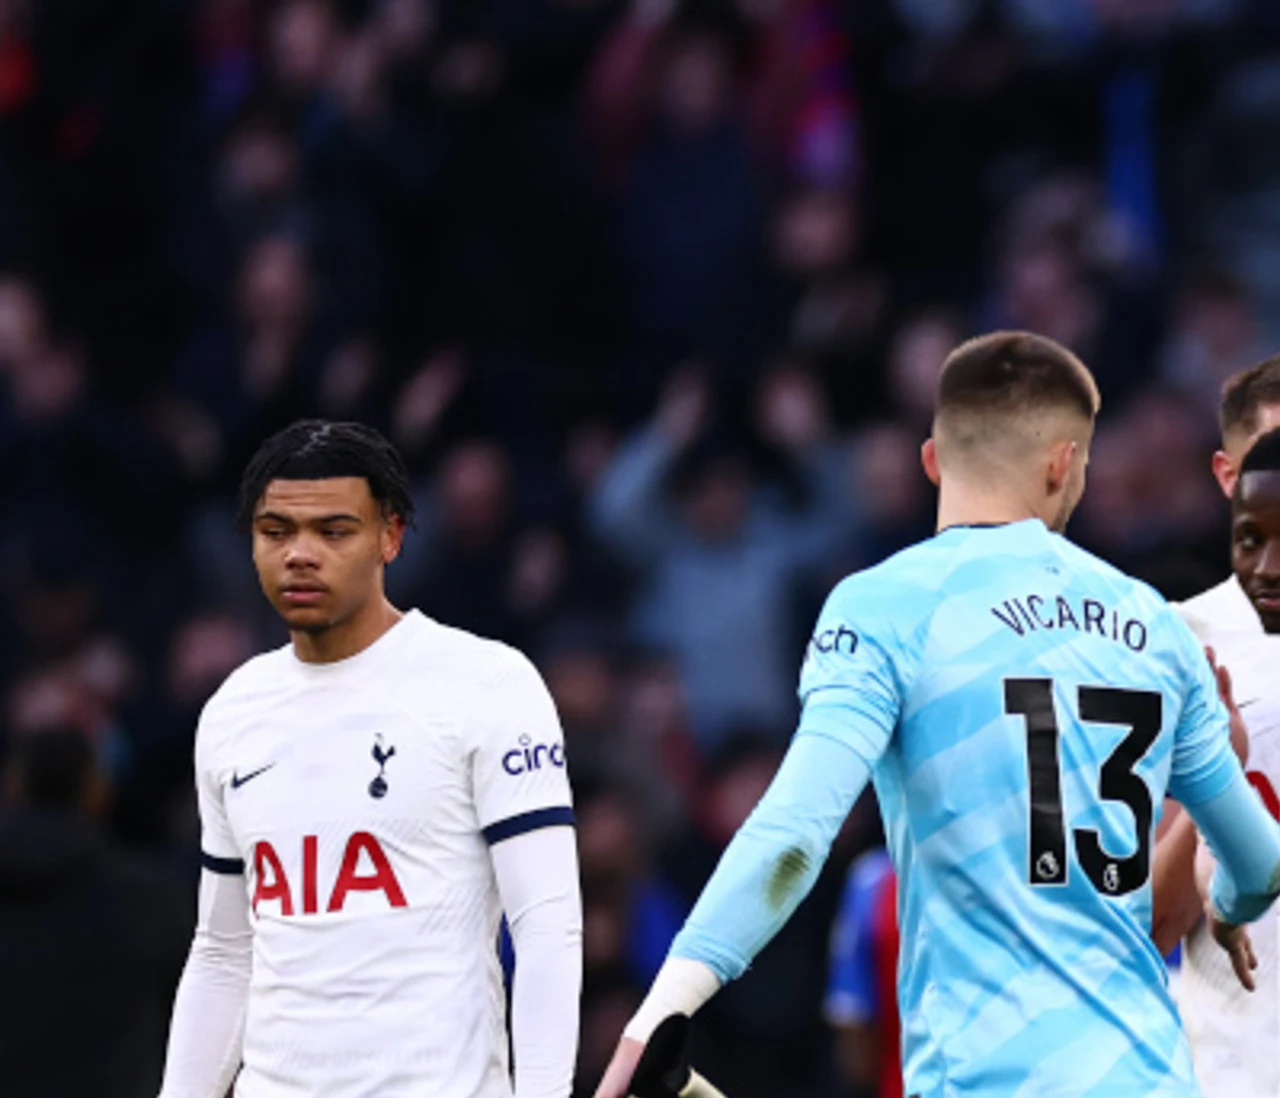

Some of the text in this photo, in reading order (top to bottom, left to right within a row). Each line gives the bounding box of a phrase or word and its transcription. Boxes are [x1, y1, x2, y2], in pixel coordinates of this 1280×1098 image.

[992, 594, 1148, 653] VICARIO
[1001, 676, 1163, 897] 13
[252, 830, 408, 921] AIA
